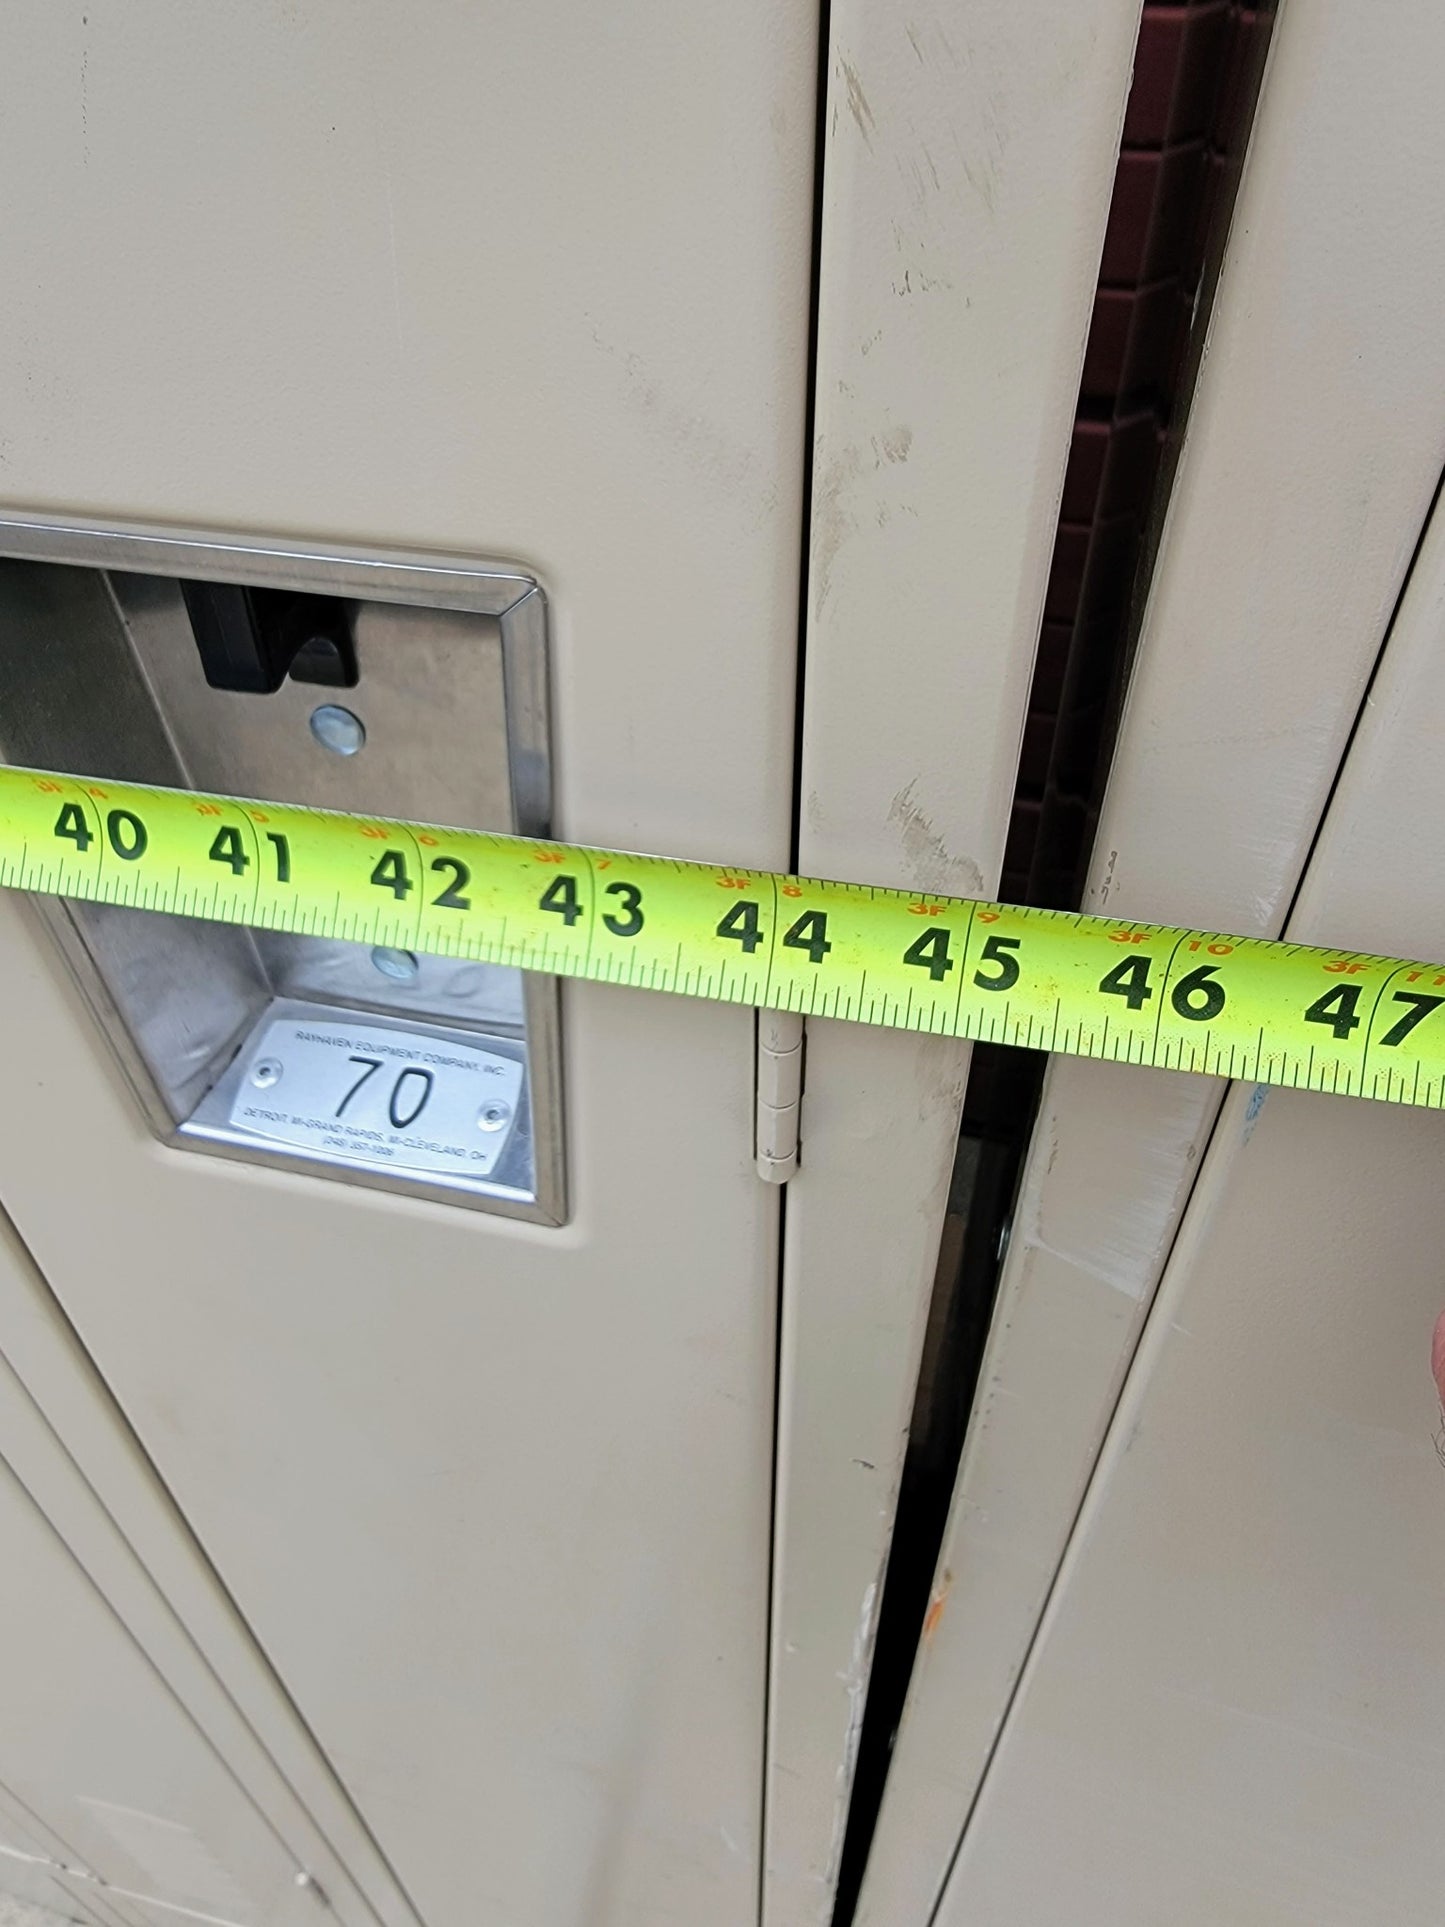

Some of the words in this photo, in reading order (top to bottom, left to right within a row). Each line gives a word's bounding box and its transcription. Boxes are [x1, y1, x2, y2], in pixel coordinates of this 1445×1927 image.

[54, 803, 149, 861] 40
[209, 825, 291, 883] 41
[370, 849, 471, 910] 42
[539, 875, 644, 937] 43
[716, 900, 831, 963] 44
[902, 927, 1021, 992] 45
[1099, 955, 1226, 1021] 46
[1304, 984, 1445, 1047] 47
[359, 825, 390, 840] 3F
[418, 833, 440, 848] 6
[534, 851, 567, 864] 3F
[595, 858, 612, 871] 7
[715, 876, 753, 890] 3F
[782, 885, 803, 898] 8
[907, 903, 948, 918] 3F
[977, 910, 1000, 925] 9
[1108, 930, 1151, 945] 3F
[1188, 939, 1233, 956] 10
[1323, 960, 1371, 975] 3F
[294, 1030, 352, 1050] RAYHAVEN
[354, 1040, 422, 1061] EQUIPMENT
[335, 1055, 435, 1129] 70
